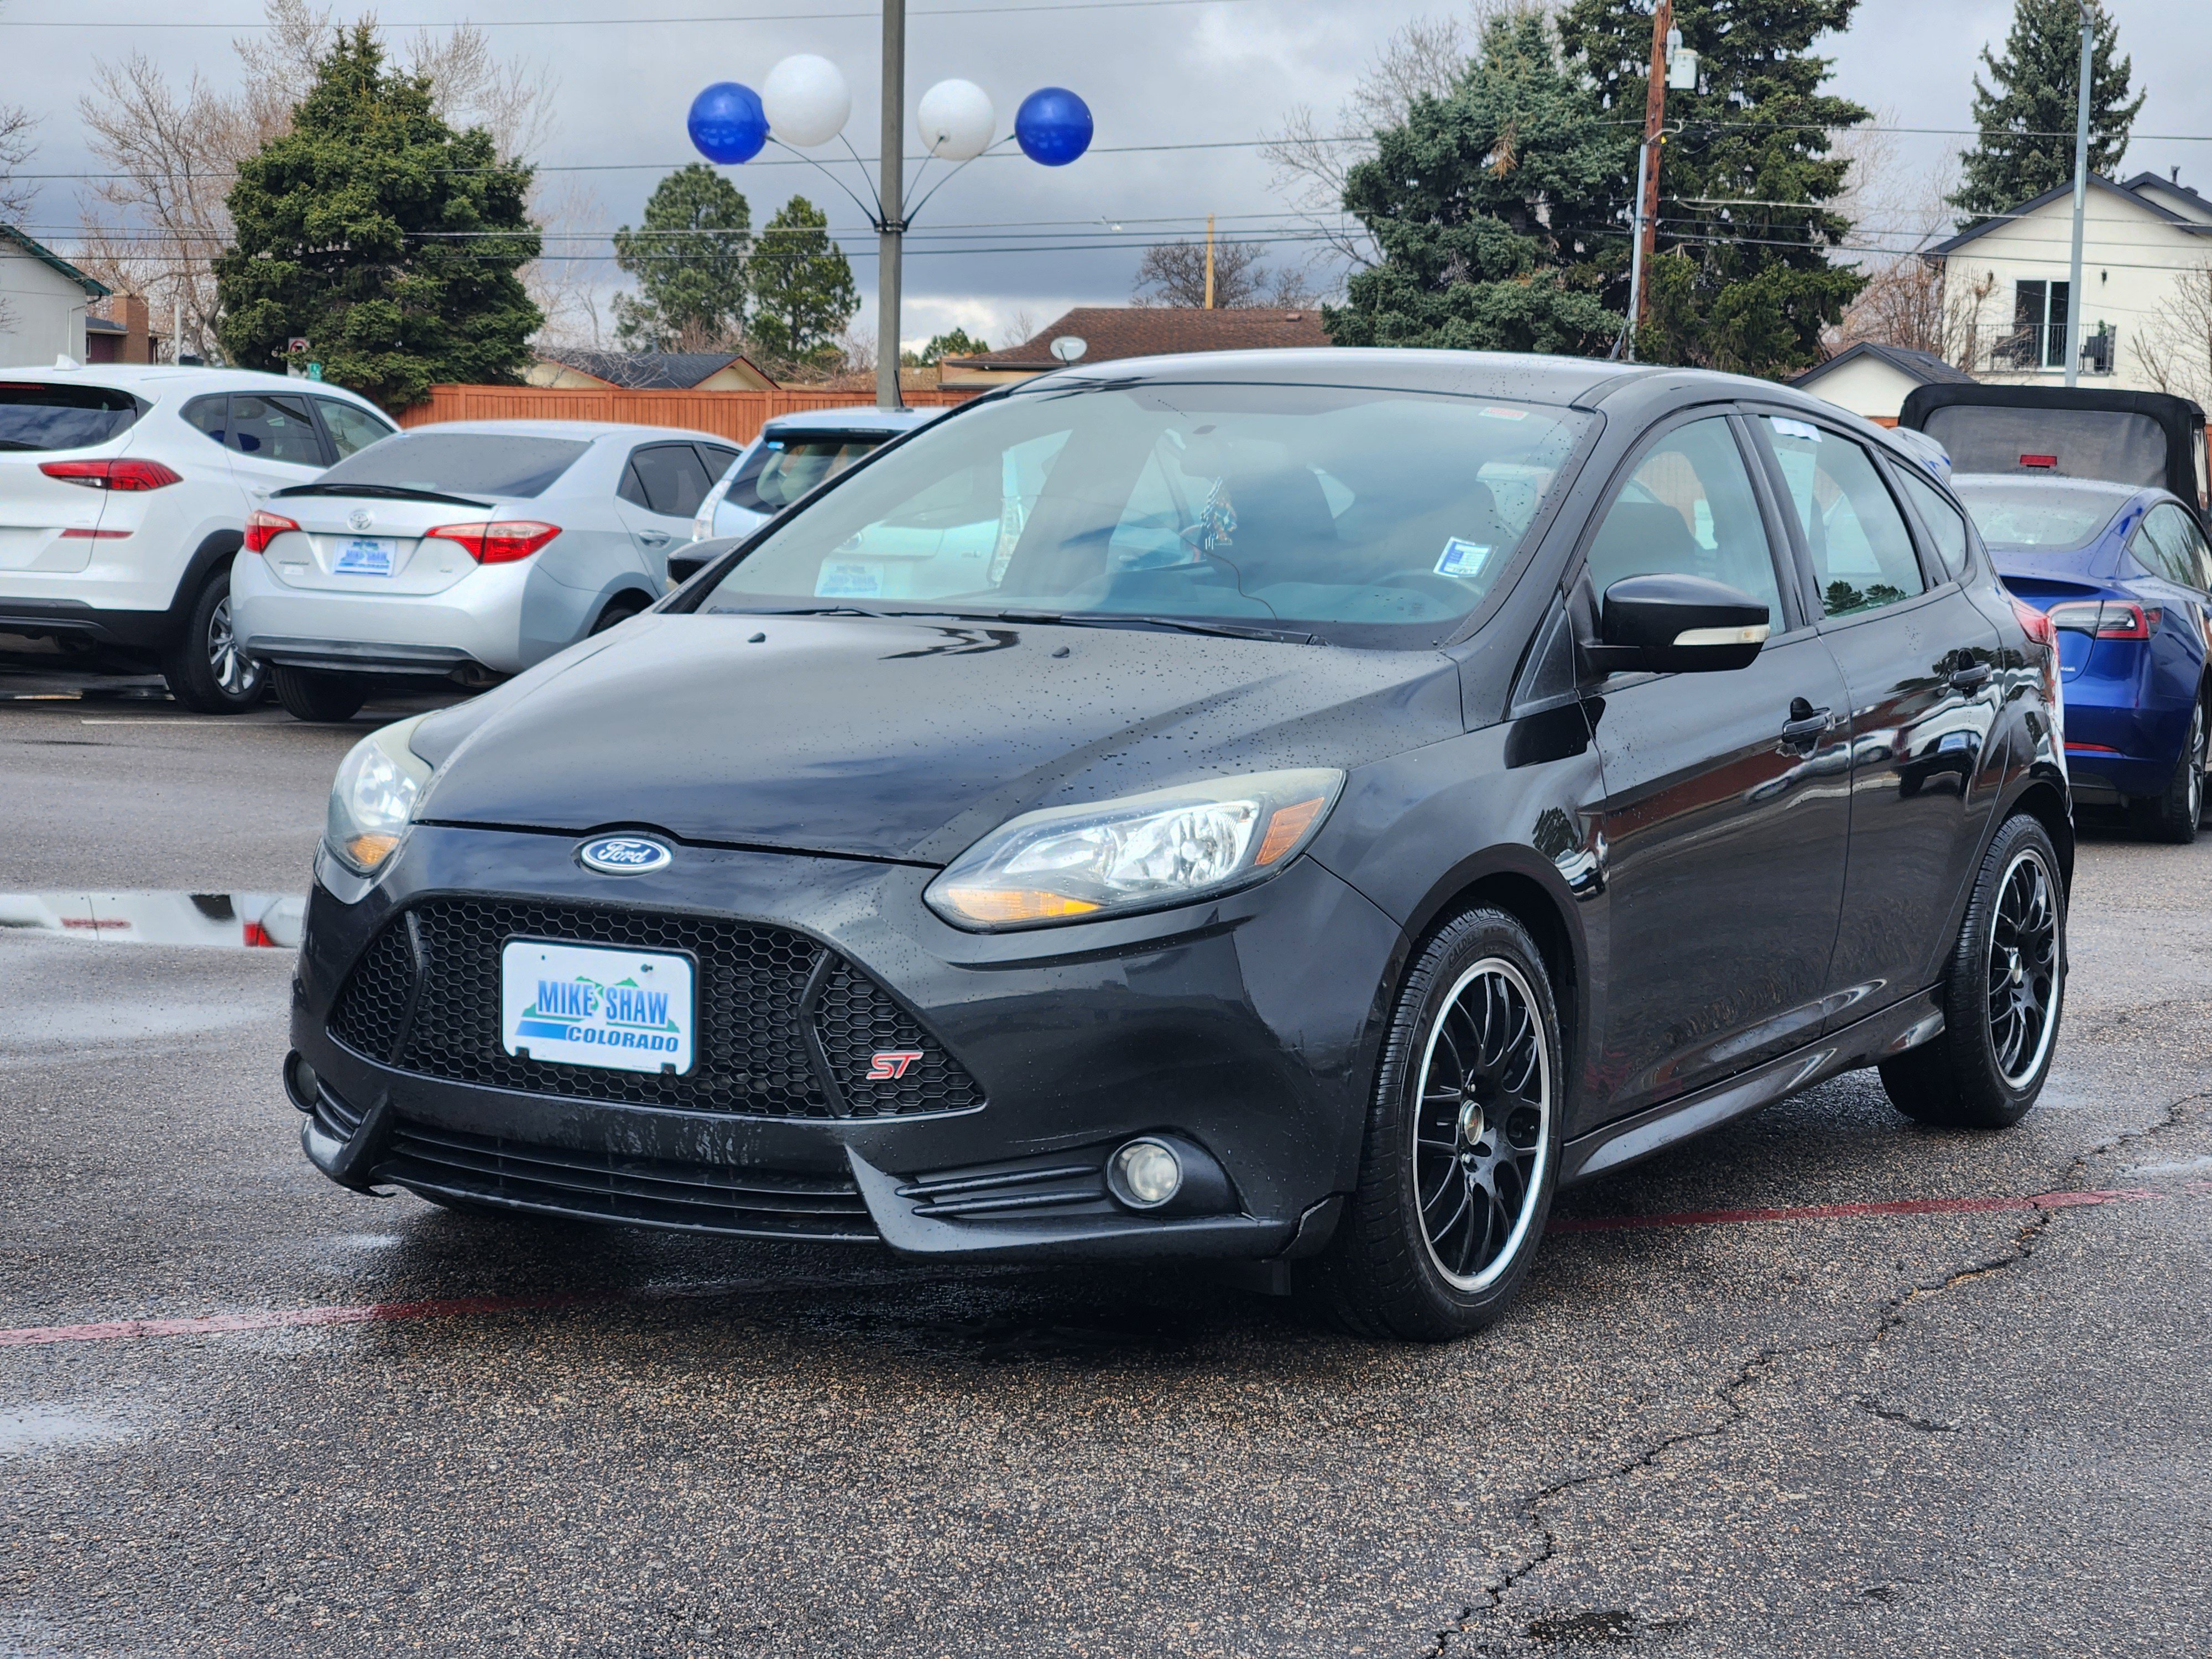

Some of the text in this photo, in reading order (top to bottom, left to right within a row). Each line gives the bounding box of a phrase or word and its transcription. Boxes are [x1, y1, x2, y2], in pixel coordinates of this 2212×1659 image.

[597, 841, 651, 863] Ford
[538, 980, 668, 1025] MIKE SHAW
[568, 1027, 679, 1052] COLORADO
[865, 1052, 924, 1079] ST
